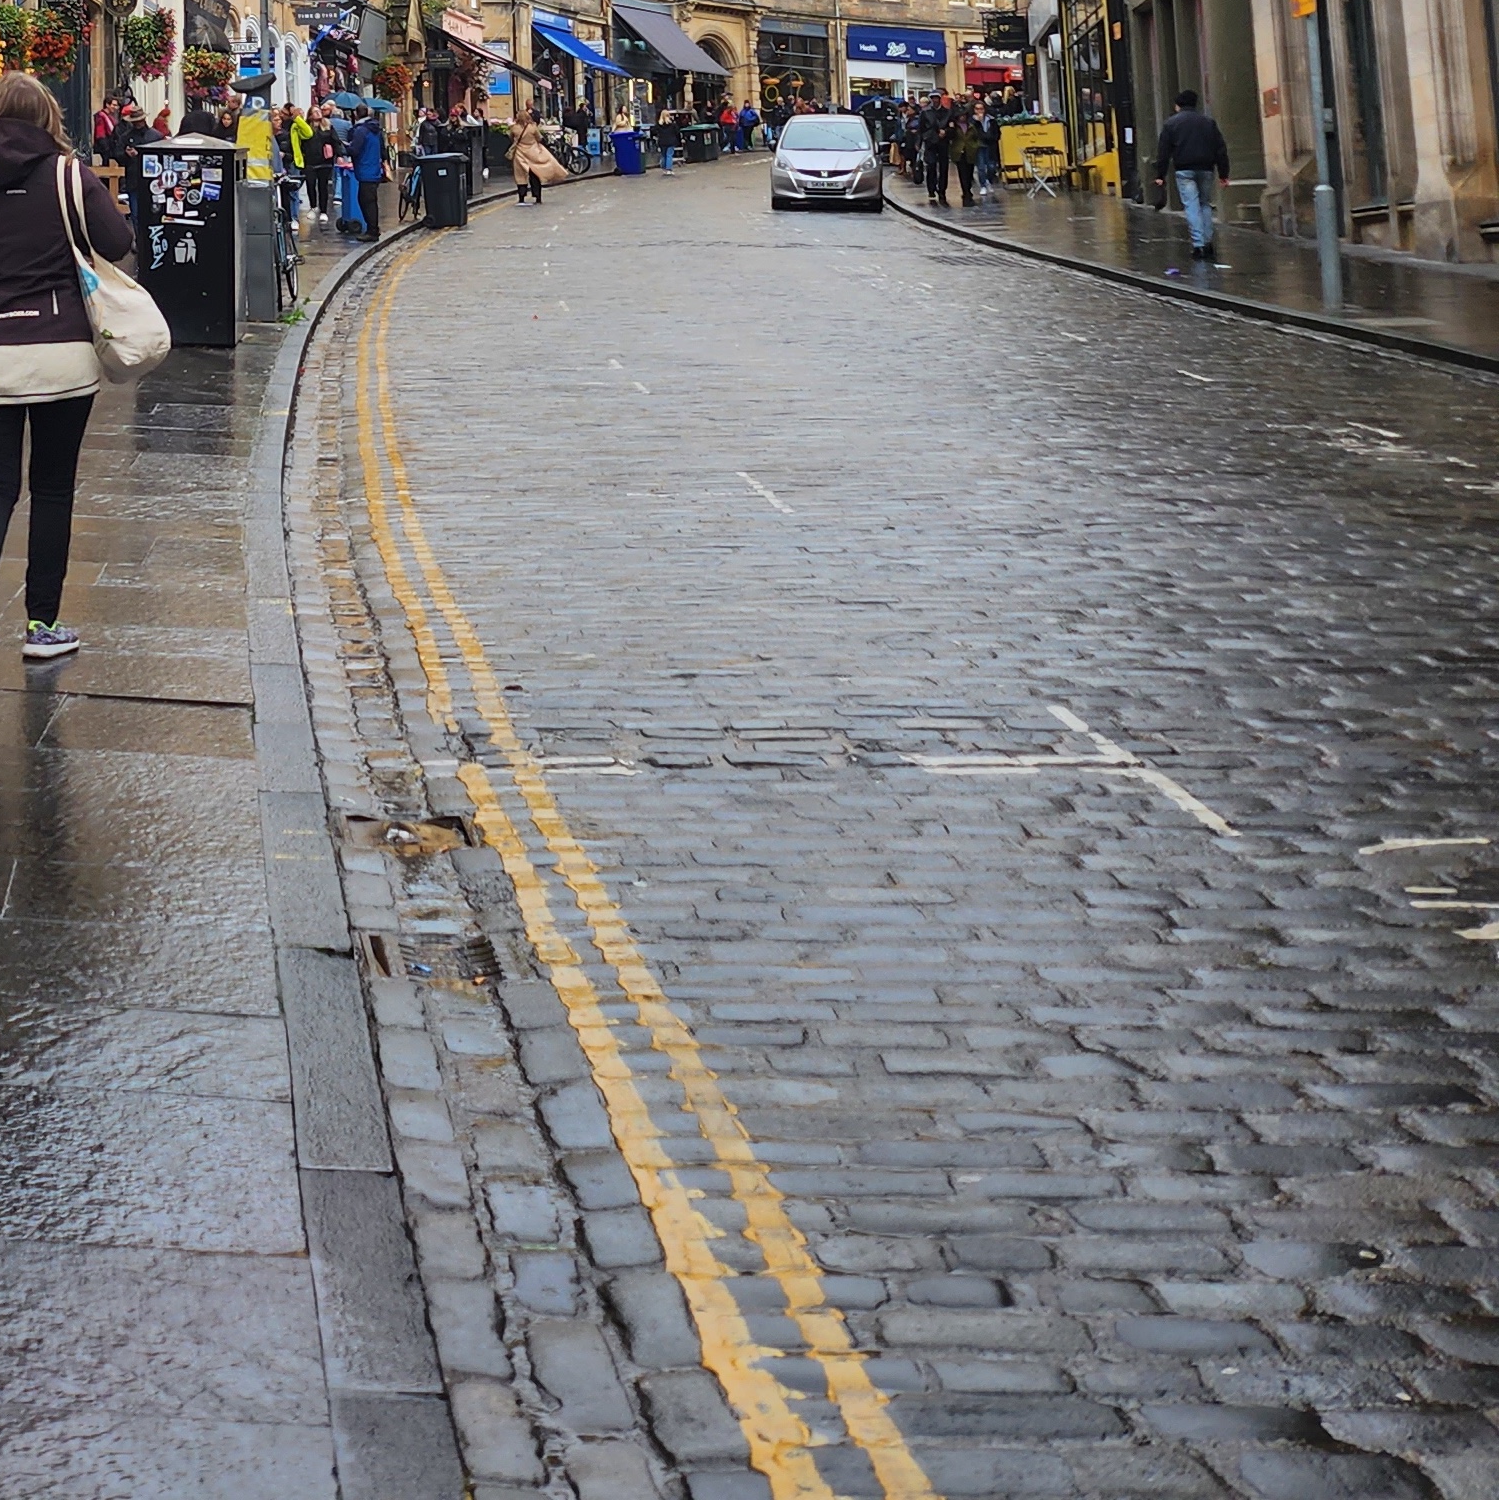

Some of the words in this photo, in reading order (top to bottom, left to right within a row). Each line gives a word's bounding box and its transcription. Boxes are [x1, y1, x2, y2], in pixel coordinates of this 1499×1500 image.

[859, 43, 878, 52] Health
[886, 41, 907, 57] Boots
[917, 47, 936, 58] Beauty
